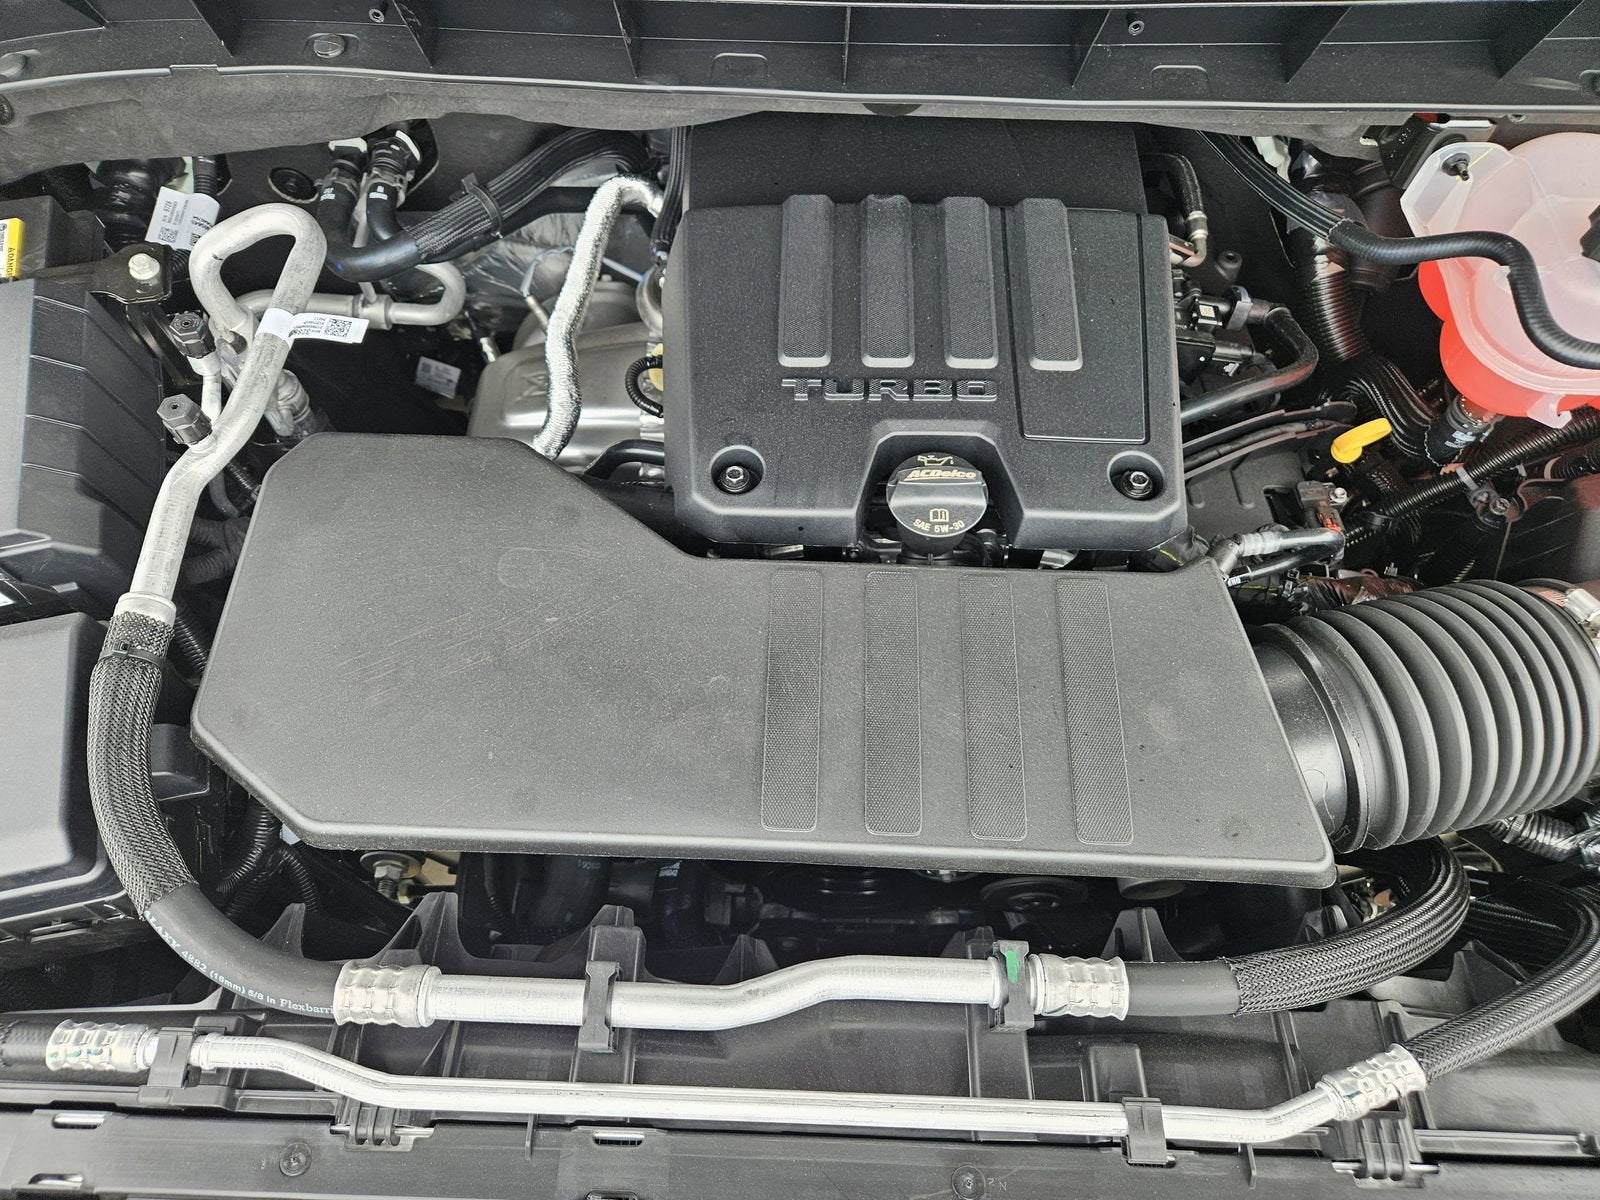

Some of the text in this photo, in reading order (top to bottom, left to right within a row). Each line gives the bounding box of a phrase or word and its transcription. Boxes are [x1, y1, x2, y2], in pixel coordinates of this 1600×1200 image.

[781, 378, 998, 402] TURBO
[904, 469, 977, 481] ACDelco
[913, 518, 965, 533] SAE 5W-30
[247, 989, 264, 1001] 5/8
